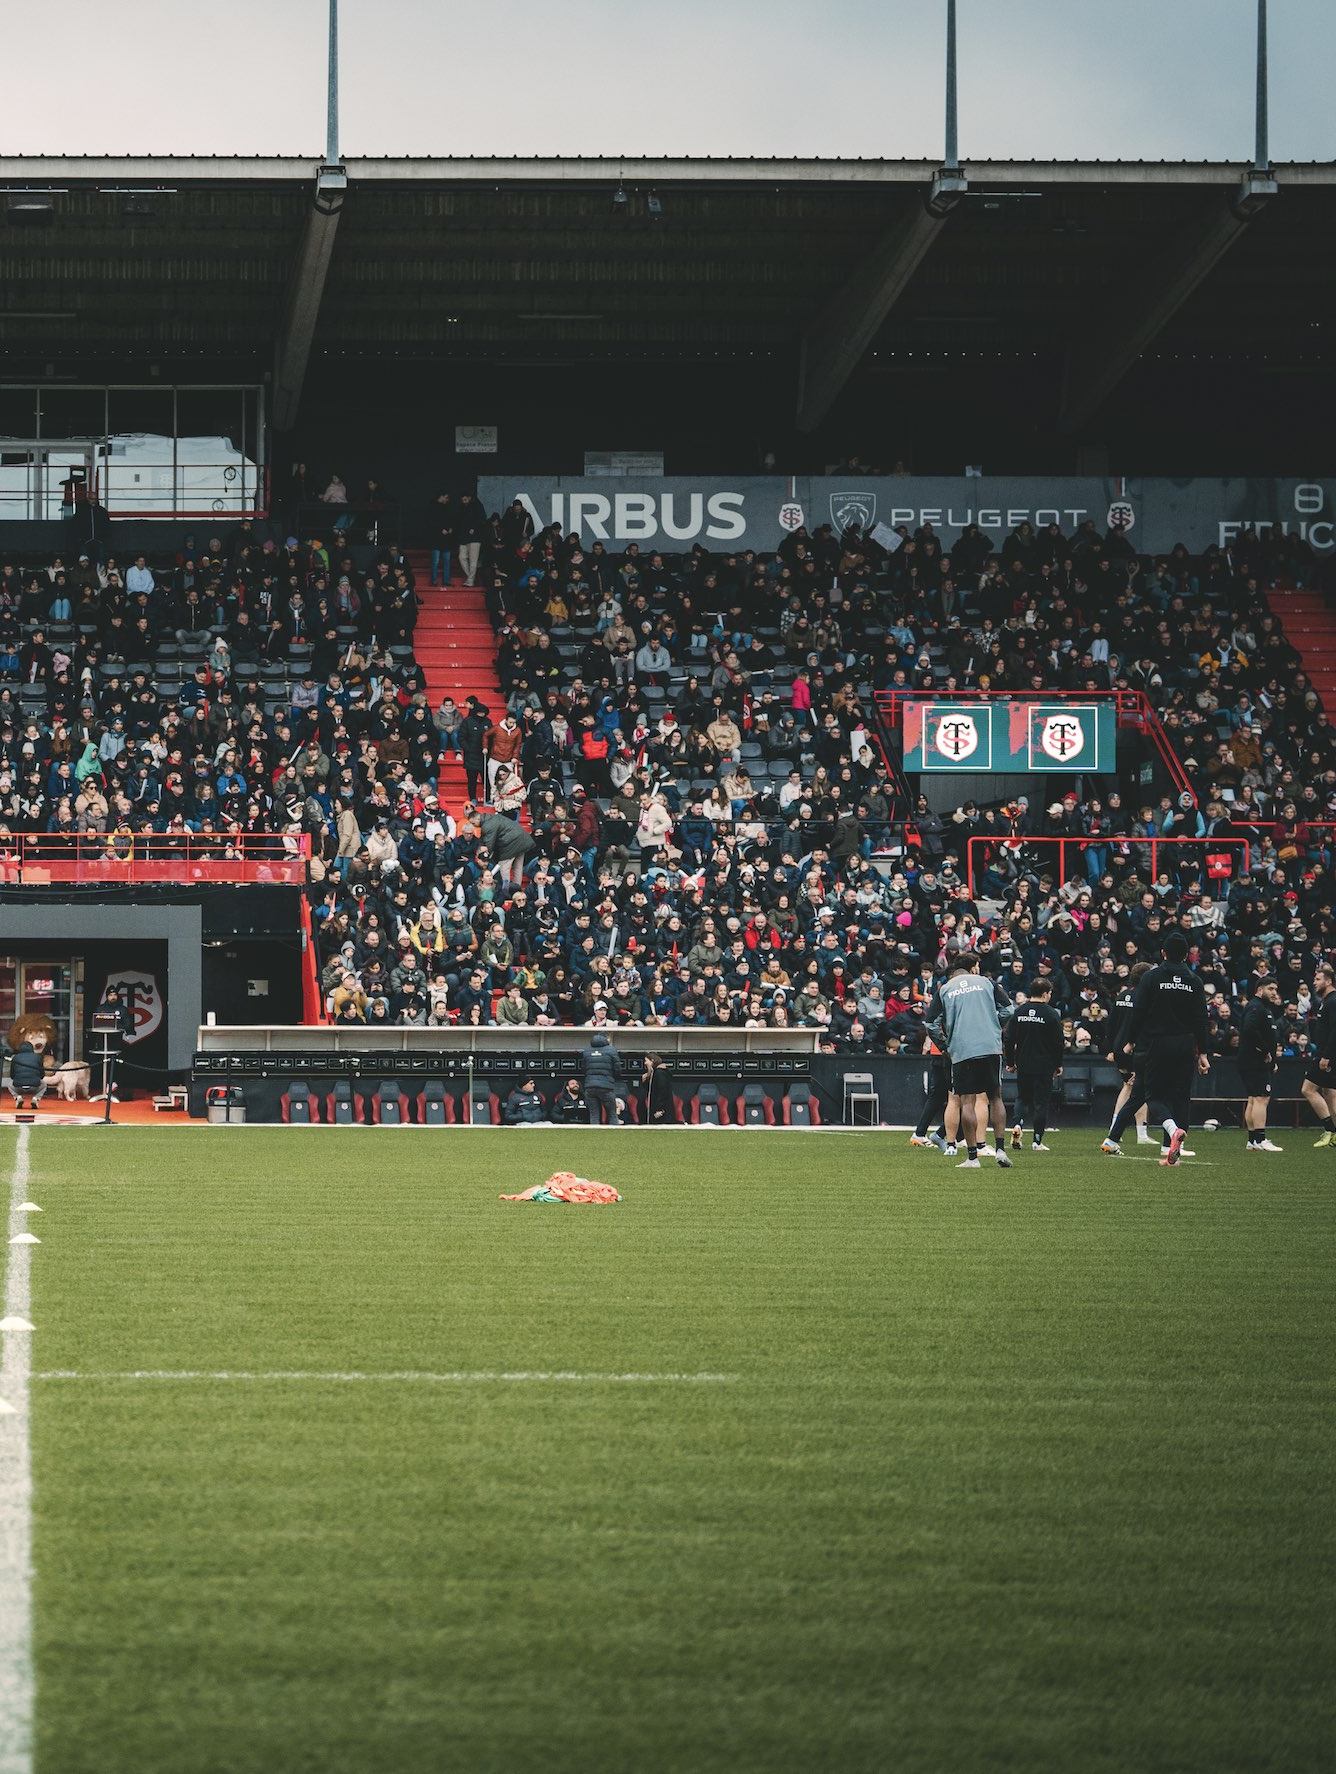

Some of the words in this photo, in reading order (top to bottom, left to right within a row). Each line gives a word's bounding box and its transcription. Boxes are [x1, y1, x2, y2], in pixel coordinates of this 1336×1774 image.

[891, 508, 1087, 528] PEUGEOT
[948, 985, 983, 999] FIDUCIAL
[1159, 983, 1194, 993] FIDUCIAL
[1017, 1015, 1046, 1024] FIDUCIAL
